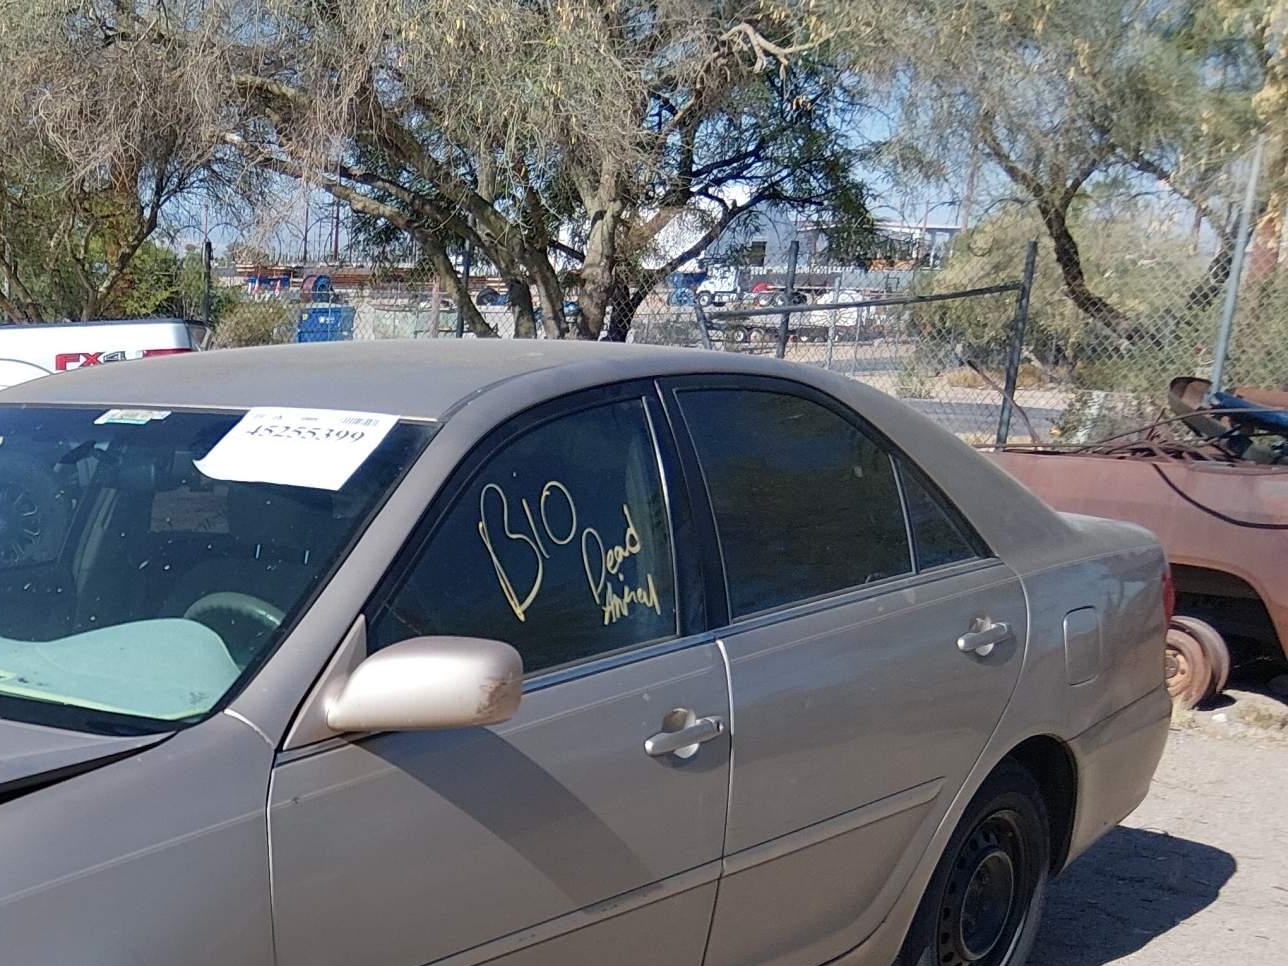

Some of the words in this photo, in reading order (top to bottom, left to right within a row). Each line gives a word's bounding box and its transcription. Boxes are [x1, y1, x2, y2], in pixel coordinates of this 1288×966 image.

[55, 350, 126, 371] FX4
[246, 424, 366, 443] 45255399
[478, 480, 577, 622] BIO
[581, 504, 642, 605] Dead
